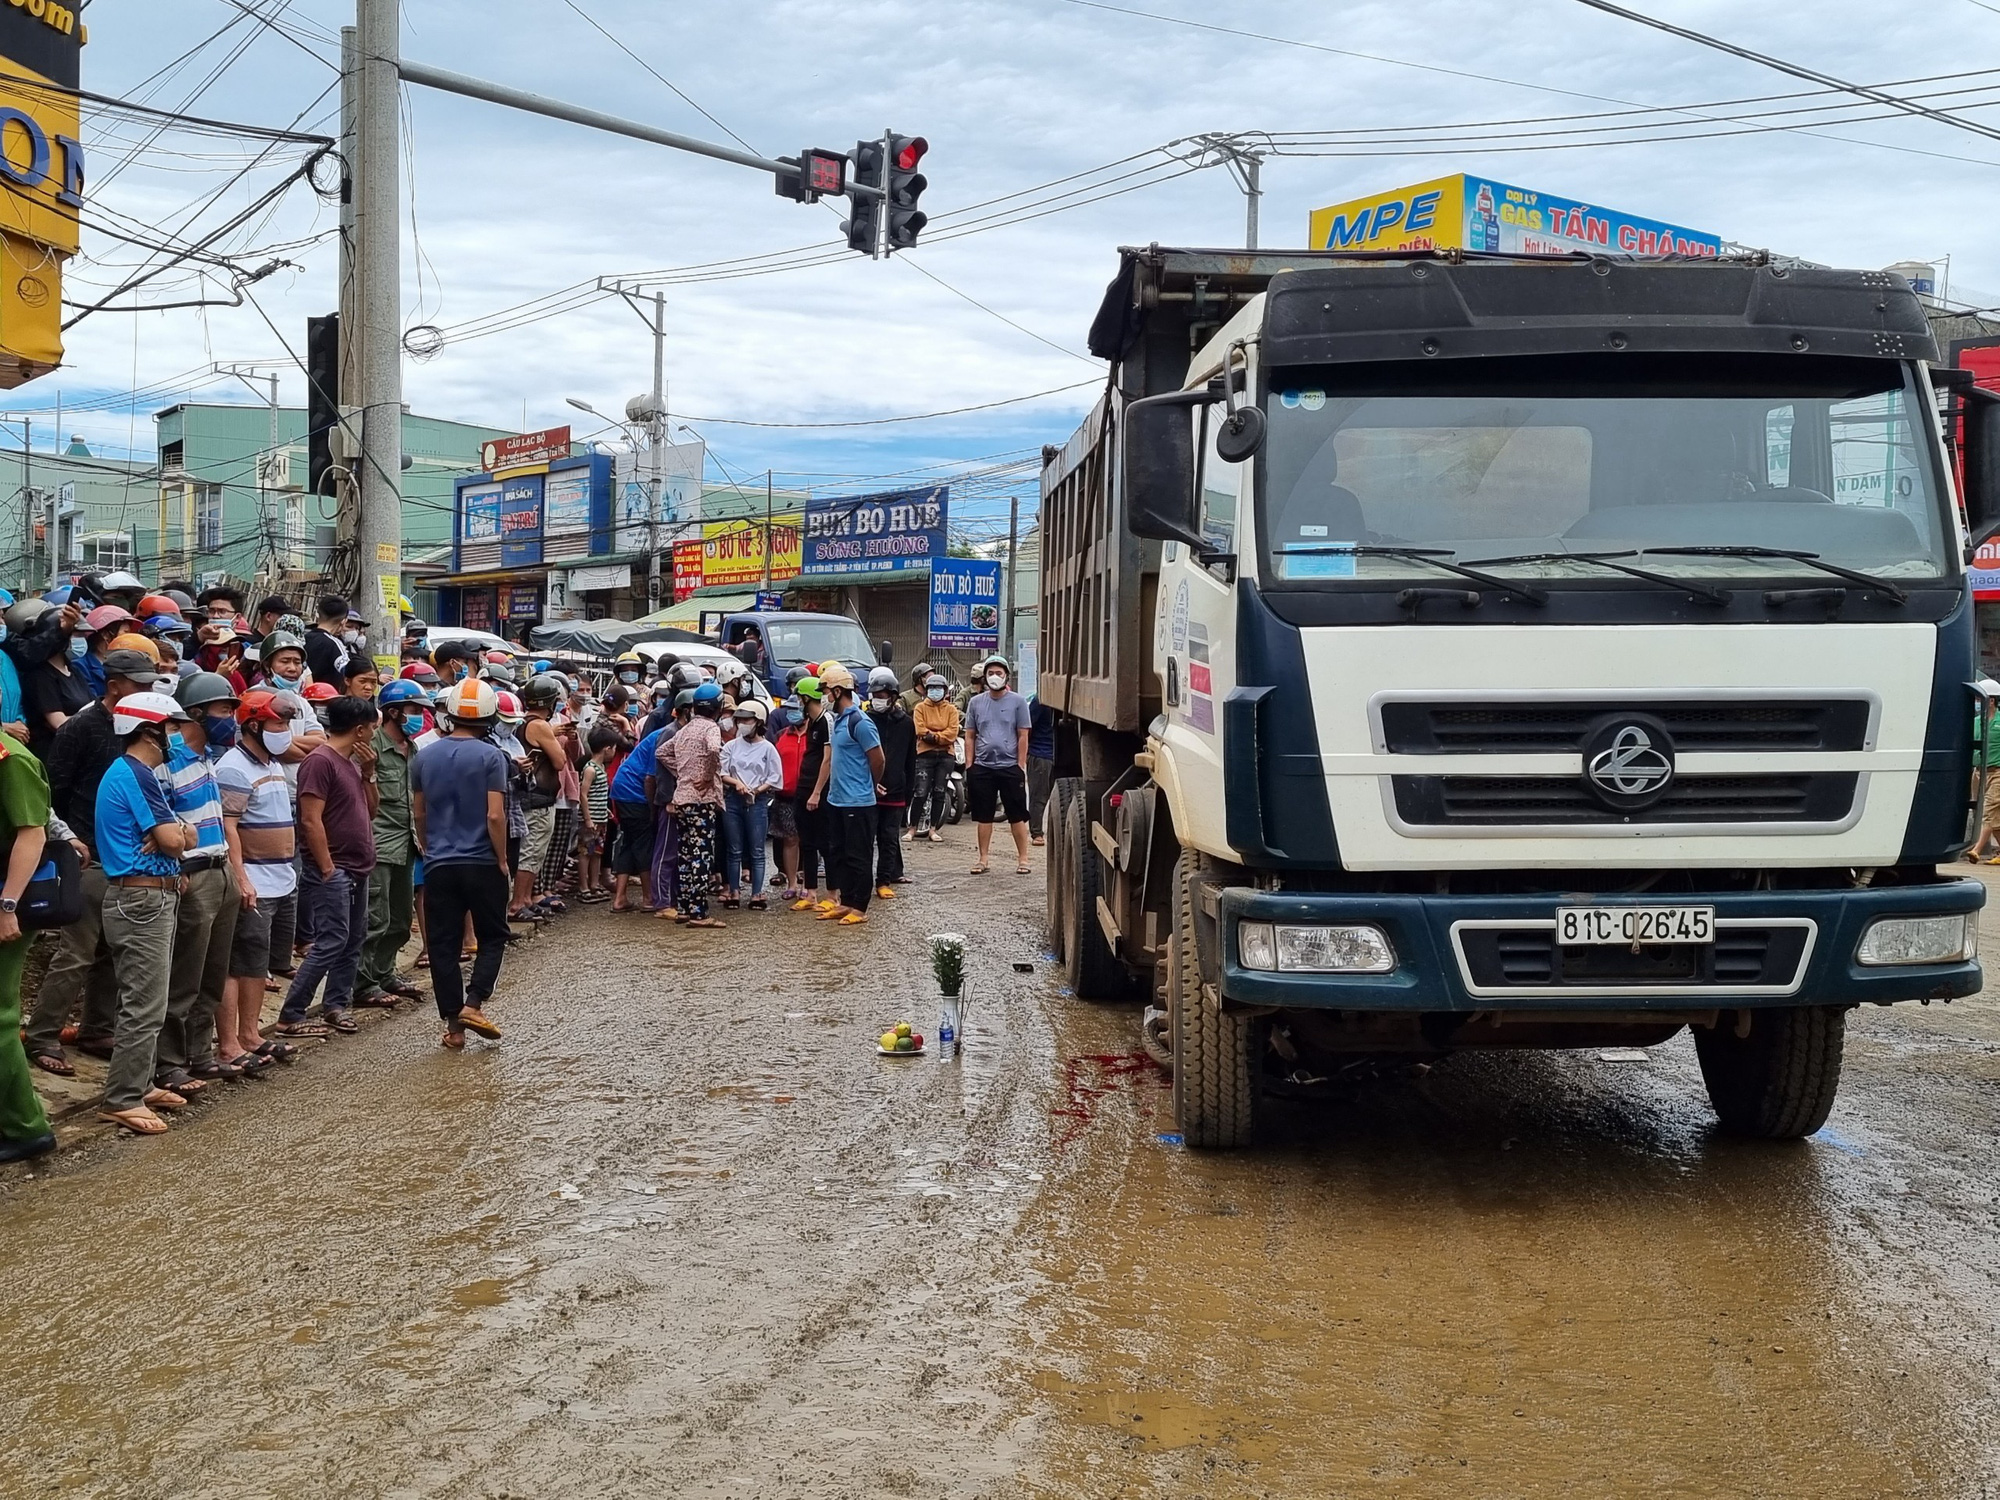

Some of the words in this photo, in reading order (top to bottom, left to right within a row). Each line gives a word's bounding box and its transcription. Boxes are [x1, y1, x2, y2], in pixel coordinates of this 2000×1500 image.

[1325, 190, 1443, 250] MPE
[1500, 202, 1543, 230] GAS
[1547, 205, 1609, 245] TẤN
[1618, 224, 1717, 256] CHÁNH
[807, 502, 850, 538] BÚN
[855, 498, 886, 535] BÒ
[889, 487, 941, 532] HUẾ
[815, 537, 862, 560] SÔNG
[865, 534, 930, 557] HƯƠNG
[934, 567, 955, 595] BÚN
[958, 569, 972, 596] BÒ
[974, 567, 996, 597] HUẾ
